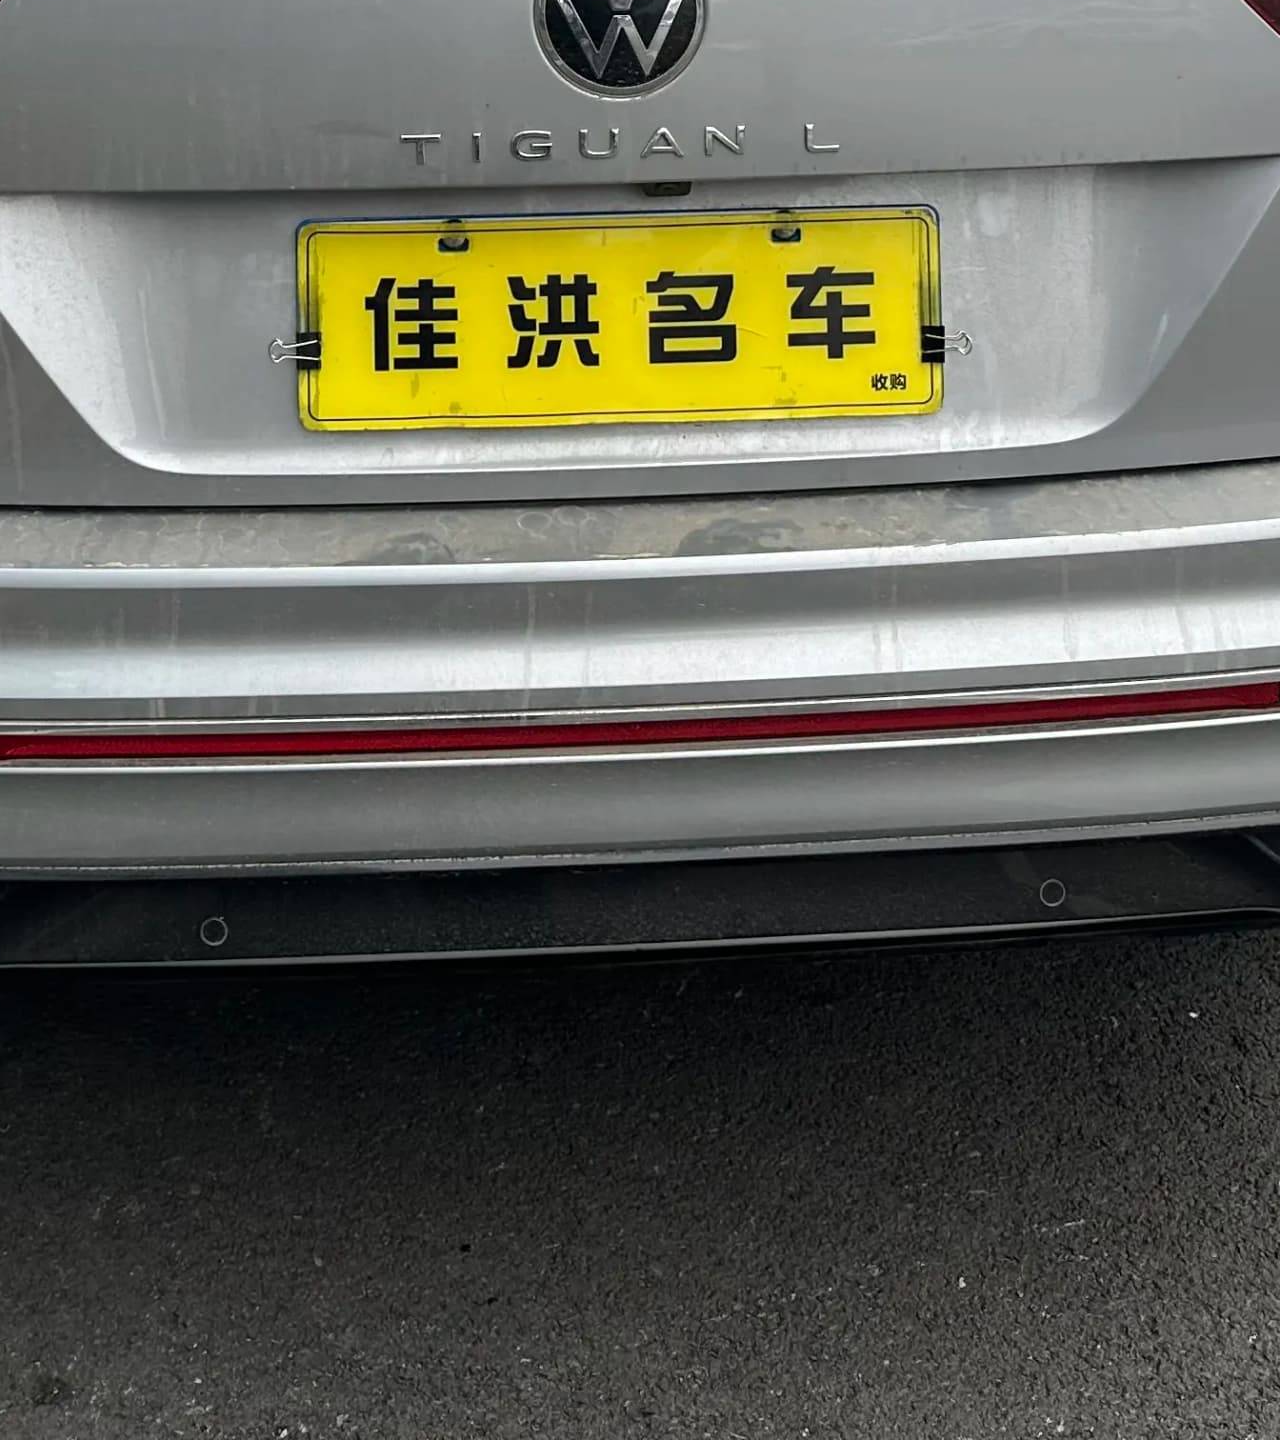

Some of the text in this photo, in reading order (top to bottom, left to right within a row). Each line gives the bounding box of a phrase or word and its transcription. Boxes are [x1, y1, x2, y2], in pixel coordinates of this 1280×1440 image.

[400, 122, 841, 164] TIGUAN L
[364, 265, 878, 373] 佳洪名车
[871, 372, 907, 392] 收购
